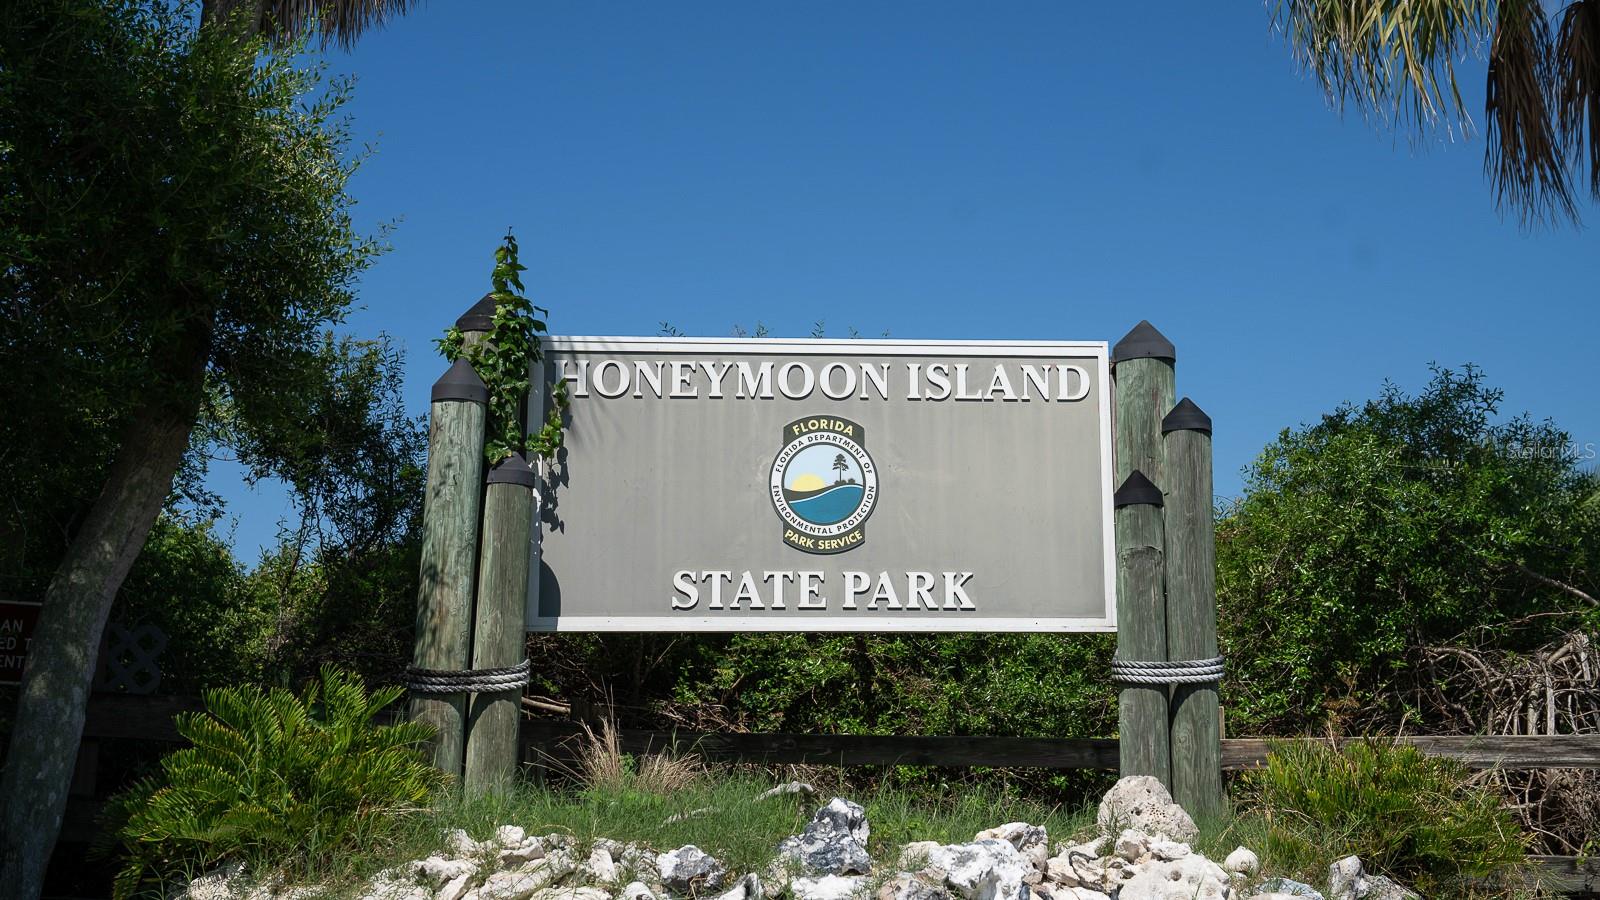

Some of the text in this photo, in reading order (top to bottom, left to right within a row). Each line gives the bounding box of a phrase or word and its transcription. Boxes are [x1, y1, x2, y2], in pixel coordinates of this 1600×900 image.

[553, 359, 1090, 402] HONEYMOON ISLAND
[792, 419, 854, 436] FLORIDA
[776, 434, 872, 475] FLORIDA DEPARTMENT OF
[772, 484, 875, 535] ENVIRONMENTAL PROTECTION
[784, 530, 863, 550] PARK SERVICE
[671, 569, 976, 611] STATE PARK
